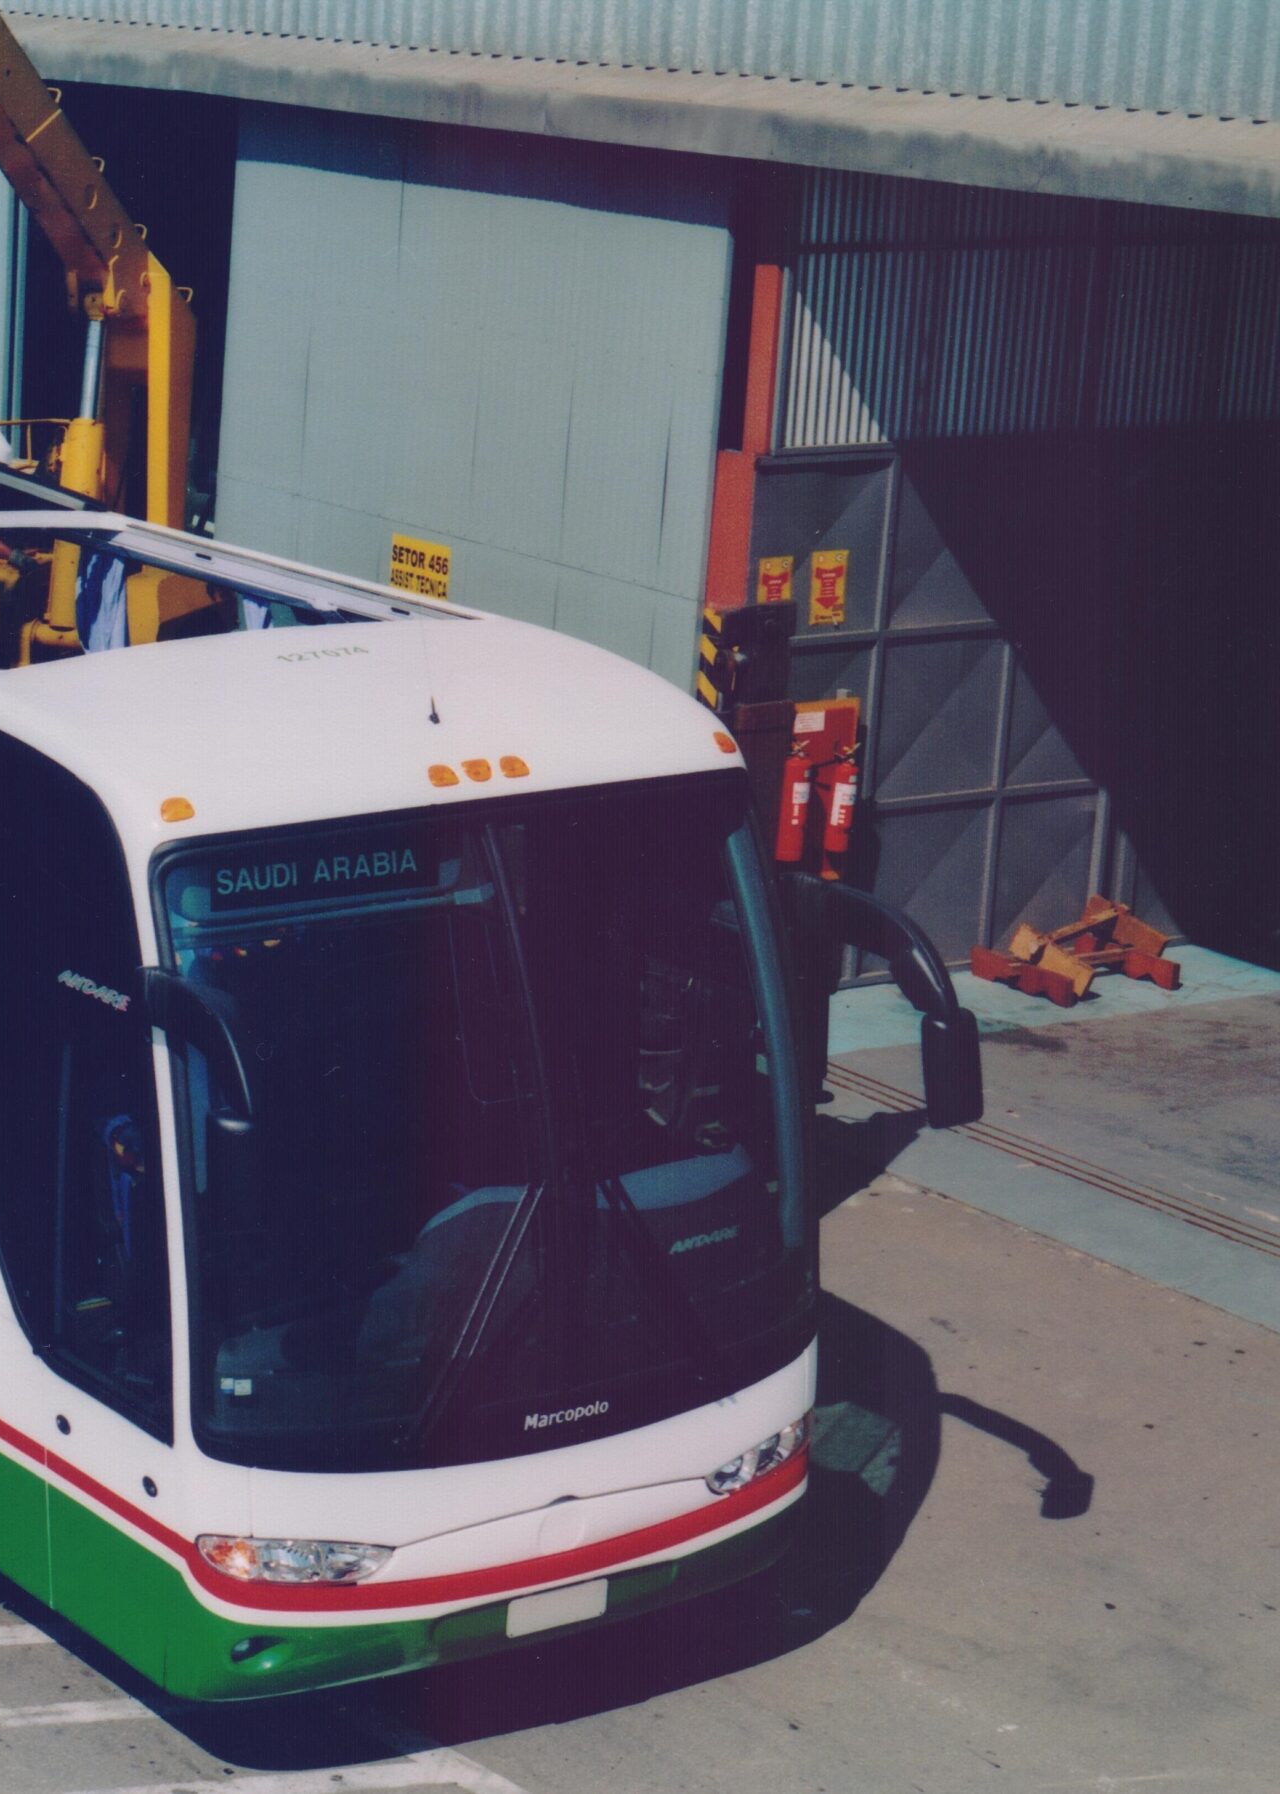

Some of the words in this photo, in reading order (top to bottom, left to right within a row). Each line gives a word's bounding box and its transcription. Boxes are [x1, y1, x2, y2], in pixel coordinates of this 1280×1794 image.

[391, 544, 425, 570] SETOR
[429, 554, 448, 576] 456
[216, 862, 298, 895] SAUDI
[313, 848, 417, 884] ARABIA
[523, 1400, 609, 1431] Marcopolo
